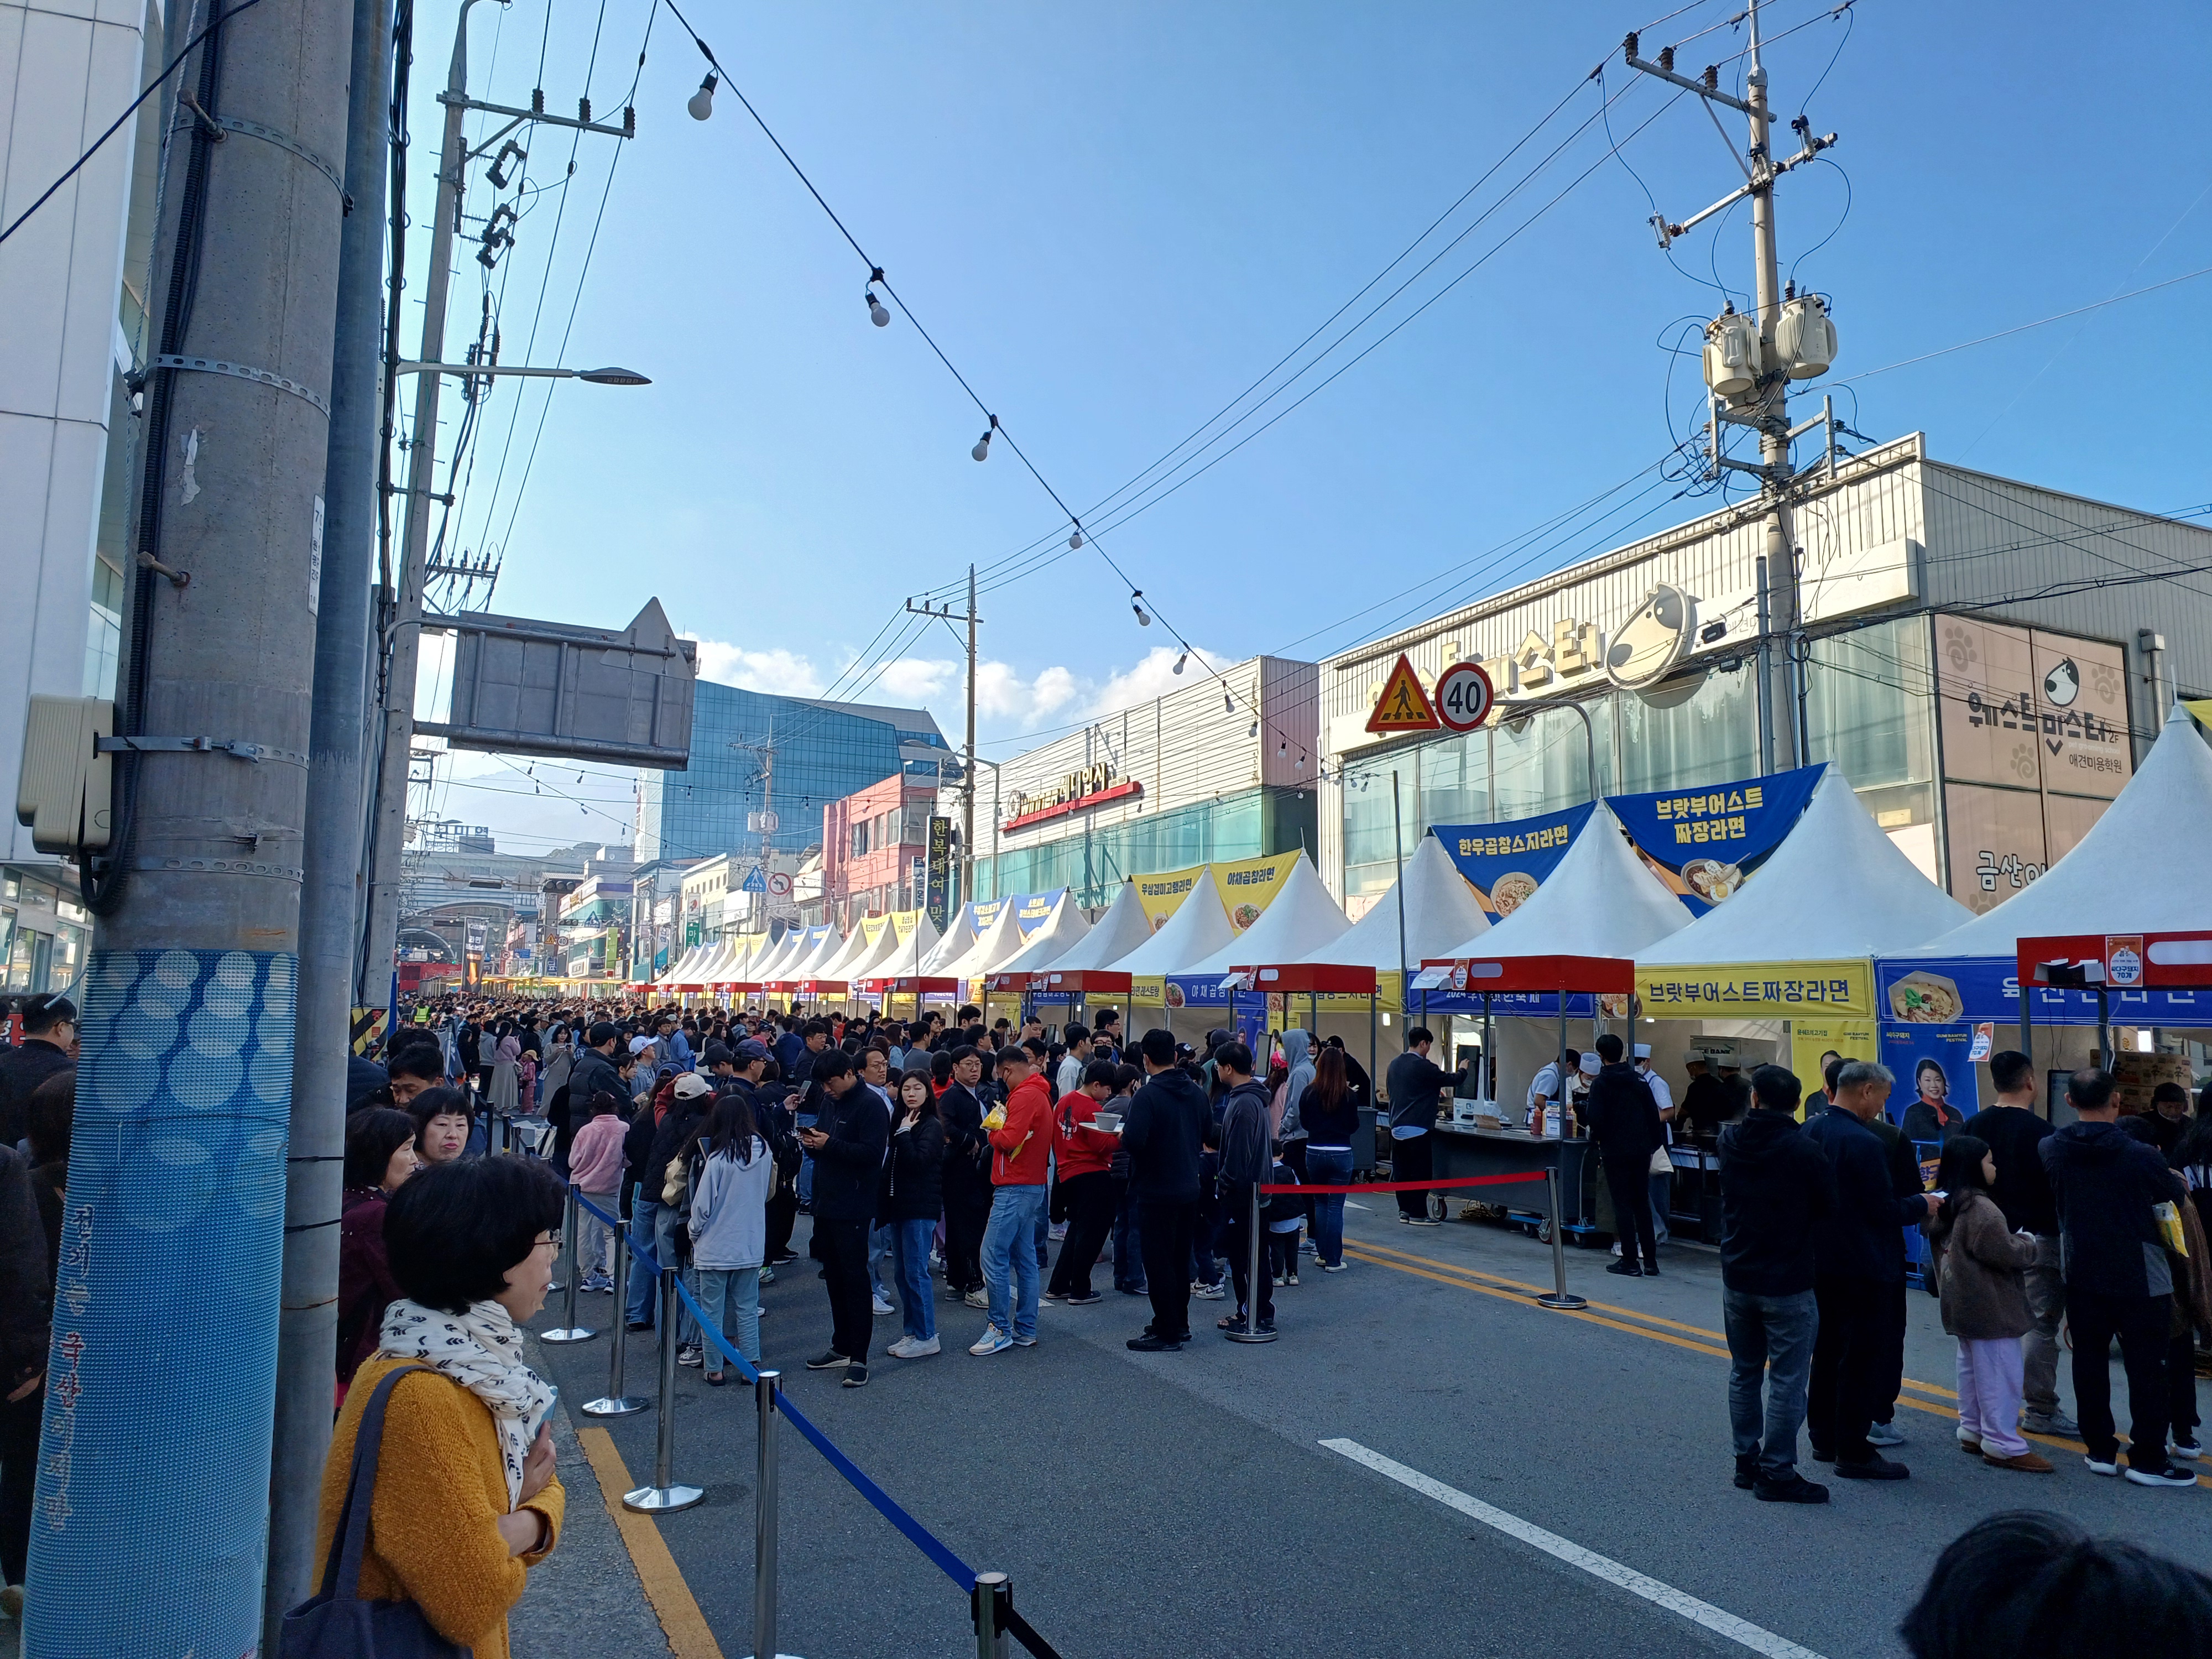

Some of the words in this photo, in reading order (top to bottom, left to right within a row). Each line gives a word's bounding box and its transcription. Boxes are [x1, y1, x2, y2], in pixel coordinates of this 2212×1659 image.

[1447, 681, 1481, 714] 40
[2078, 743, 2104, 754] grooming
[2105, 747, 2121, 755] school
[2069, 753, 2122, 774] 애견미용학원
[1020, 789, 1060, 817] WINNER
[1656, 786, 1764, 820] 브랏부어스트
[1458, 824, 1568, 857] 한우곱창스지라면
[1674, 816, 1746, 844] 짜장라면
[931, 820, 948, 895] 한복대여
[1141, 878, 1192, 896] 우삼겹미고랭라면
[1227, 867, 1275, 885] 야채곱창라면
[1191, 984, 1246, 999] 야채곱창
[1650, 979, 1850, 1003] 브랏부어스트짜장라면
